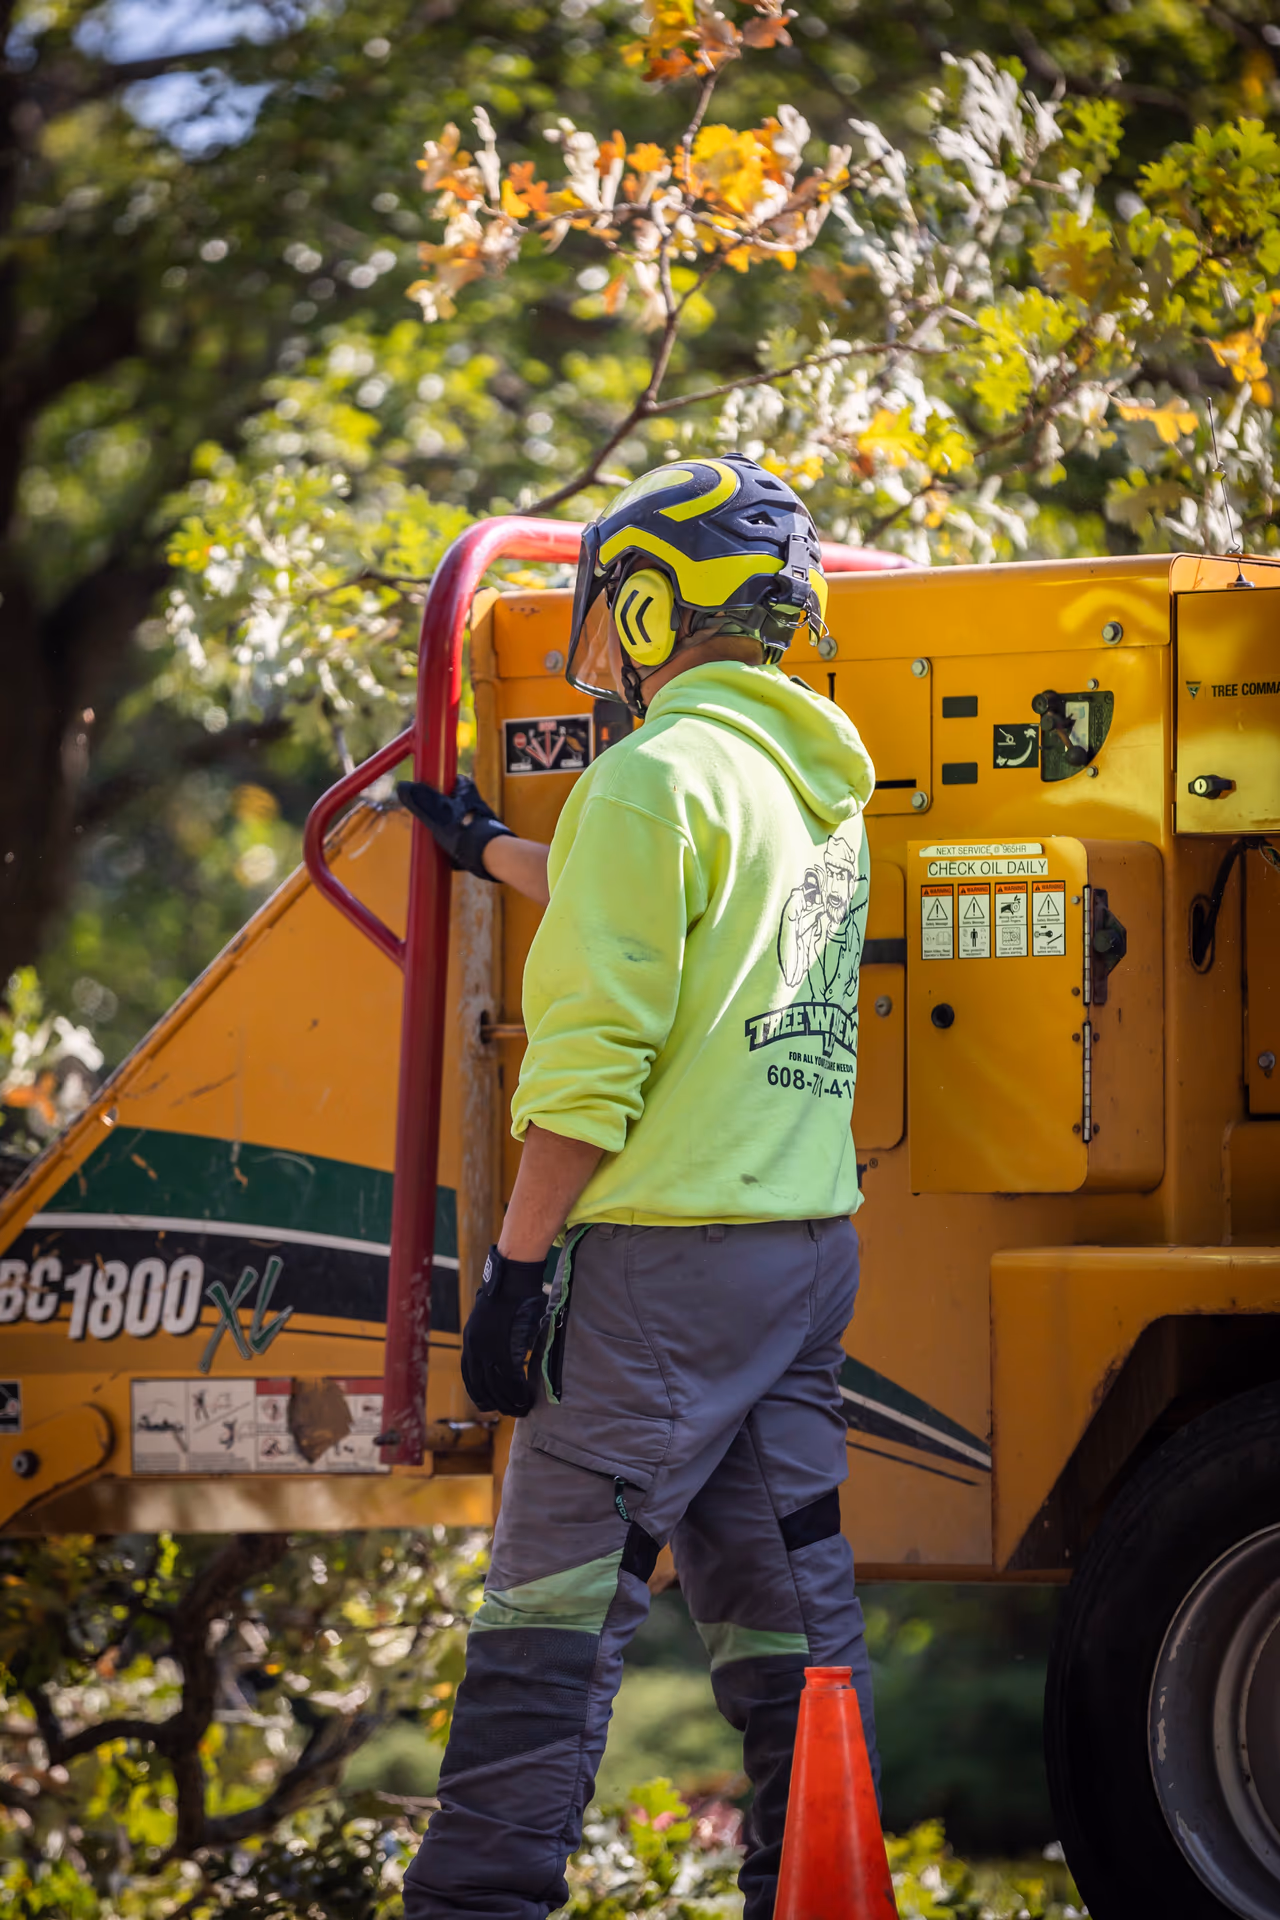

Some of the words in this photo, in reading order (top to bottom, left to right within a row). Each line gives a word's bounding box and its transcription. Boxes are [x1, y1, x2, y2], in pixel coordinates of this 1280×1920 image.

[1211, 684, 1238, 697] TREE
[936, 847, 955, 855] NEXT
[958, 846, 991, 854] SERVICE
[928, 862, 976, 877] CHECK
[980, 861, 1002, 875] OIL
[1007, 860, 1047, 874] DAILY
[748, 1005, 805, 1046] TREE
[789, 1051, 802, 1062] FOR
[803, 1053, 813, 1064] ALL
[199, 1254, 294, 1374] XL
